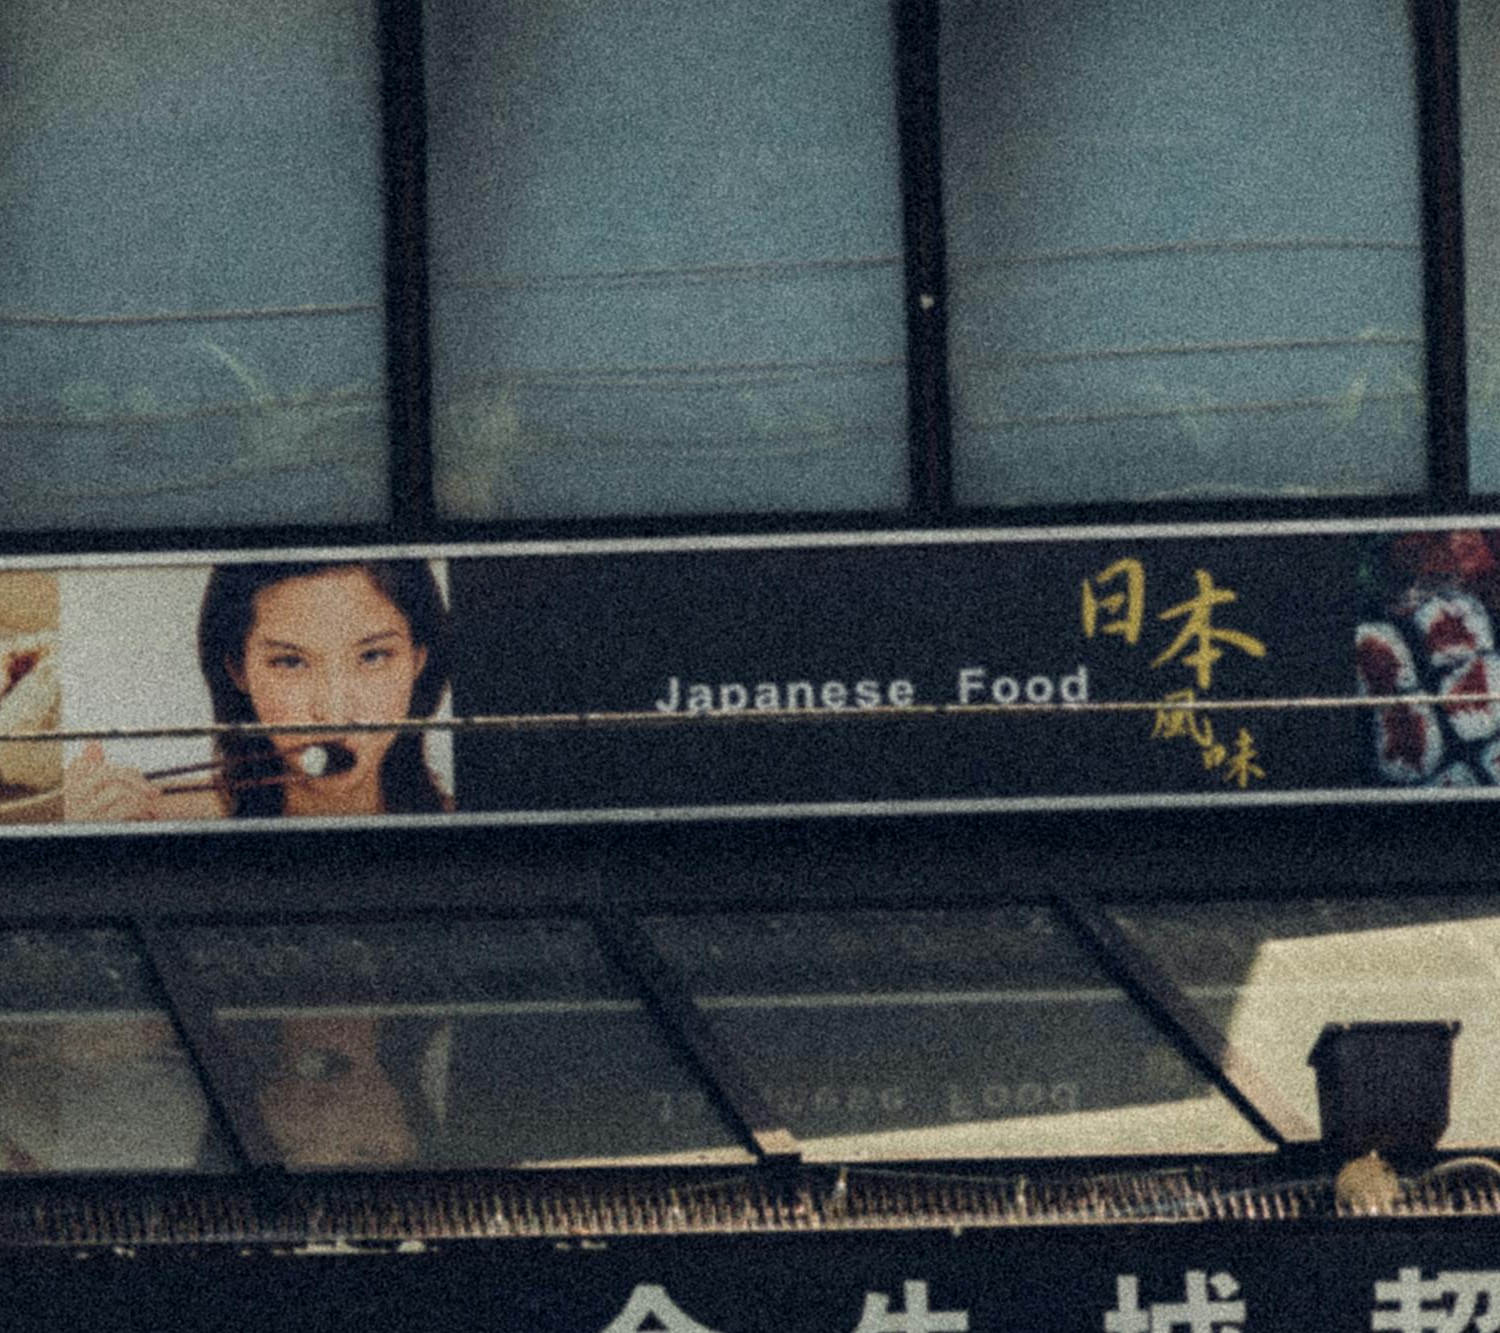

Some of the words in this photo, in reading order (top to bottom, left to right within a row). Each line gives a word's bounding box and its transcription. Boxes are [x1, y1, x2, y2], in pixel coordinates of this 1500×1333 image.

[1081, 558, 1266, 689] 日本
[655, 673, 915, 716] Japanese
[958, 667, 1090, 707] Food
